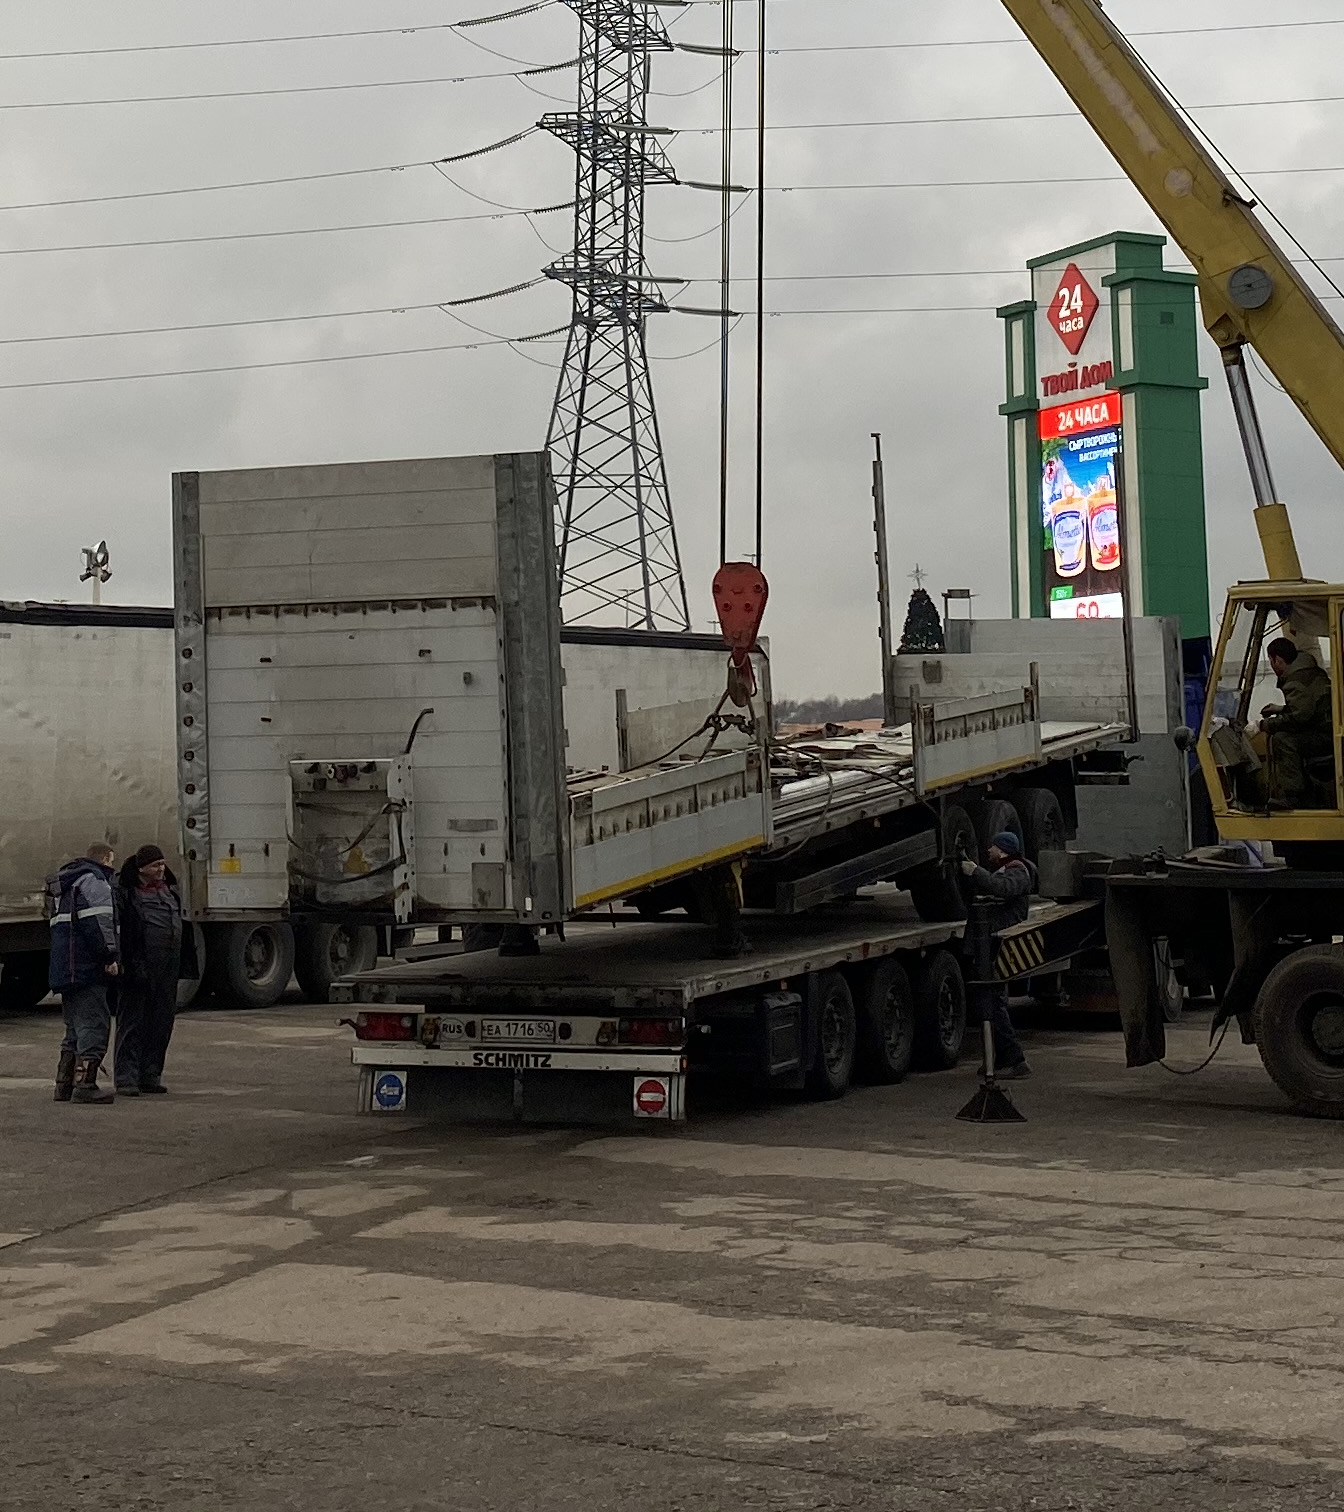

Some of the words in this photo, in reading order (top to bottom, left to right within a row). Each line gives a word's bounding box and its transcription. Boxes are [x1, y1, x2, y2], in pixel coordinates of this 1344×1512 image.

[1058, 284, 1084, 319] 24
[1059, 316, 1084, 334] часа
[1041, 361, 1078, 397] ТВОЙ
[1080, 360, 1113, 390] ДОМ
[1057, 411, 1074, 432] 24
[1075, 402, 1109, 426] ЧАСА
[442, 1023, 463, 1034] RUS
[505, 1022, 535, 1037] 1716
[472, 1052, 552, 1068] SCHMITZ
